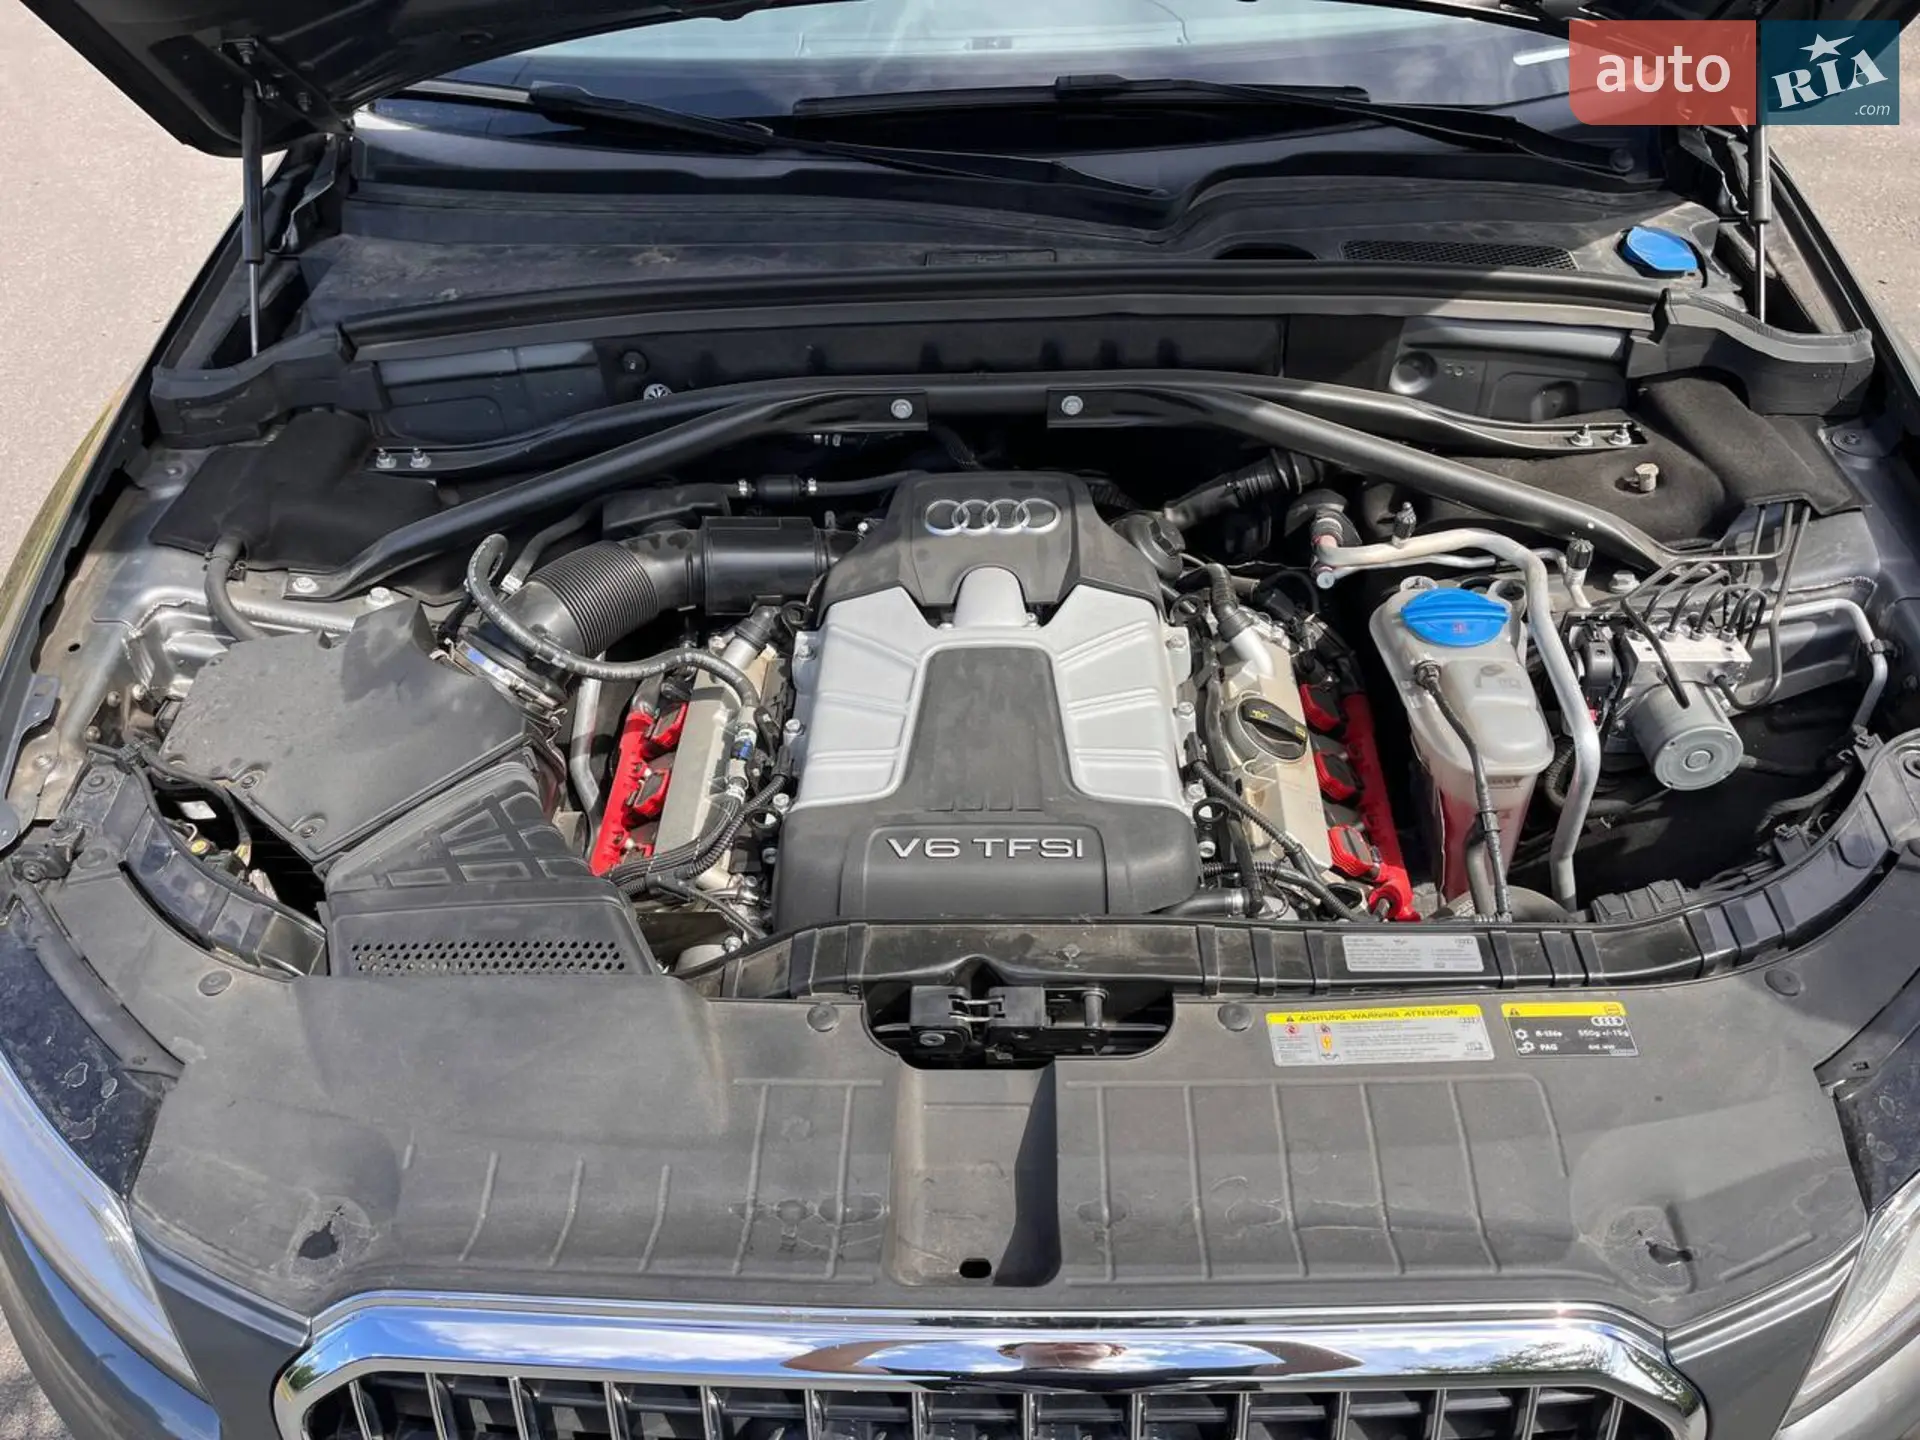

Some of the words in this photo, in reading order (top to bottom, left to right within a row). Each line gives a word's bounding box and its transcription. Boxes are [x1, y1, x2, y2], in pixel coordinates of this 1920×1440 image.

[887, 837, 961, 859] V6
[972, 837, 1084, 859] TFSI
[1299, 1013, 1347, 1022] ACHTUNG
[1350, 1010, 1400, 1020] WARNING
[1403, 1007, 1458, 1018] ATTENTION
[1539, 1043, 1559, 1052] PAG
